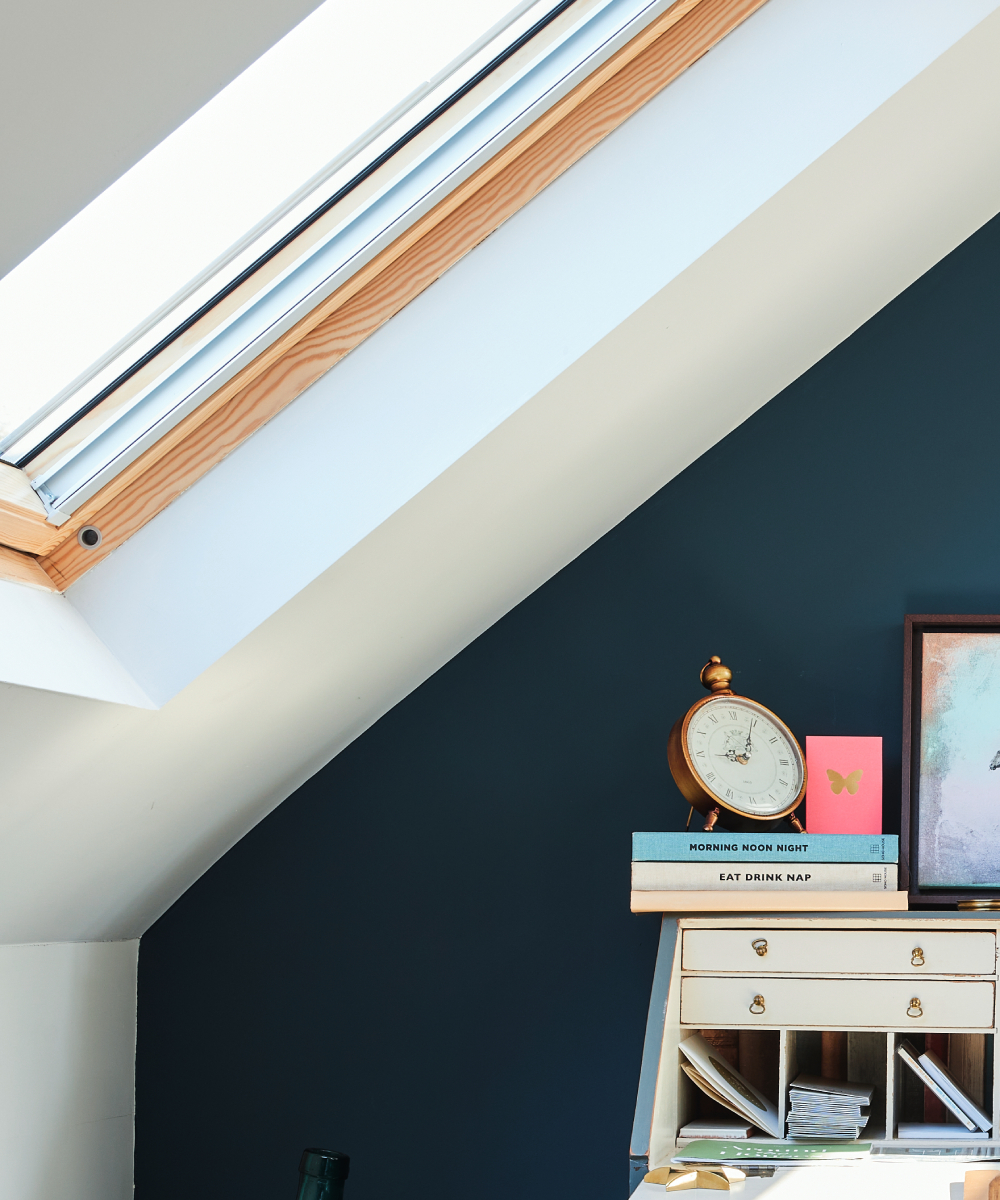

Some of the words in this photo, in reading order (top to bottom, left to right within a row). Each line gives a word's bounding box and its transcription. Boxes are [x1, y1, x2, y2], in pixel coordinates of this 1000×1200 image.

[689, 843, 738, 851] MORNING
[742, 844, 773, 852] NOON
[777, 844, 808, 852] NIGHT
[719, 873, 741, 881] EAT
[745, 873, 783, 882] DRINK
[787, 874, 811, 882] NAP
